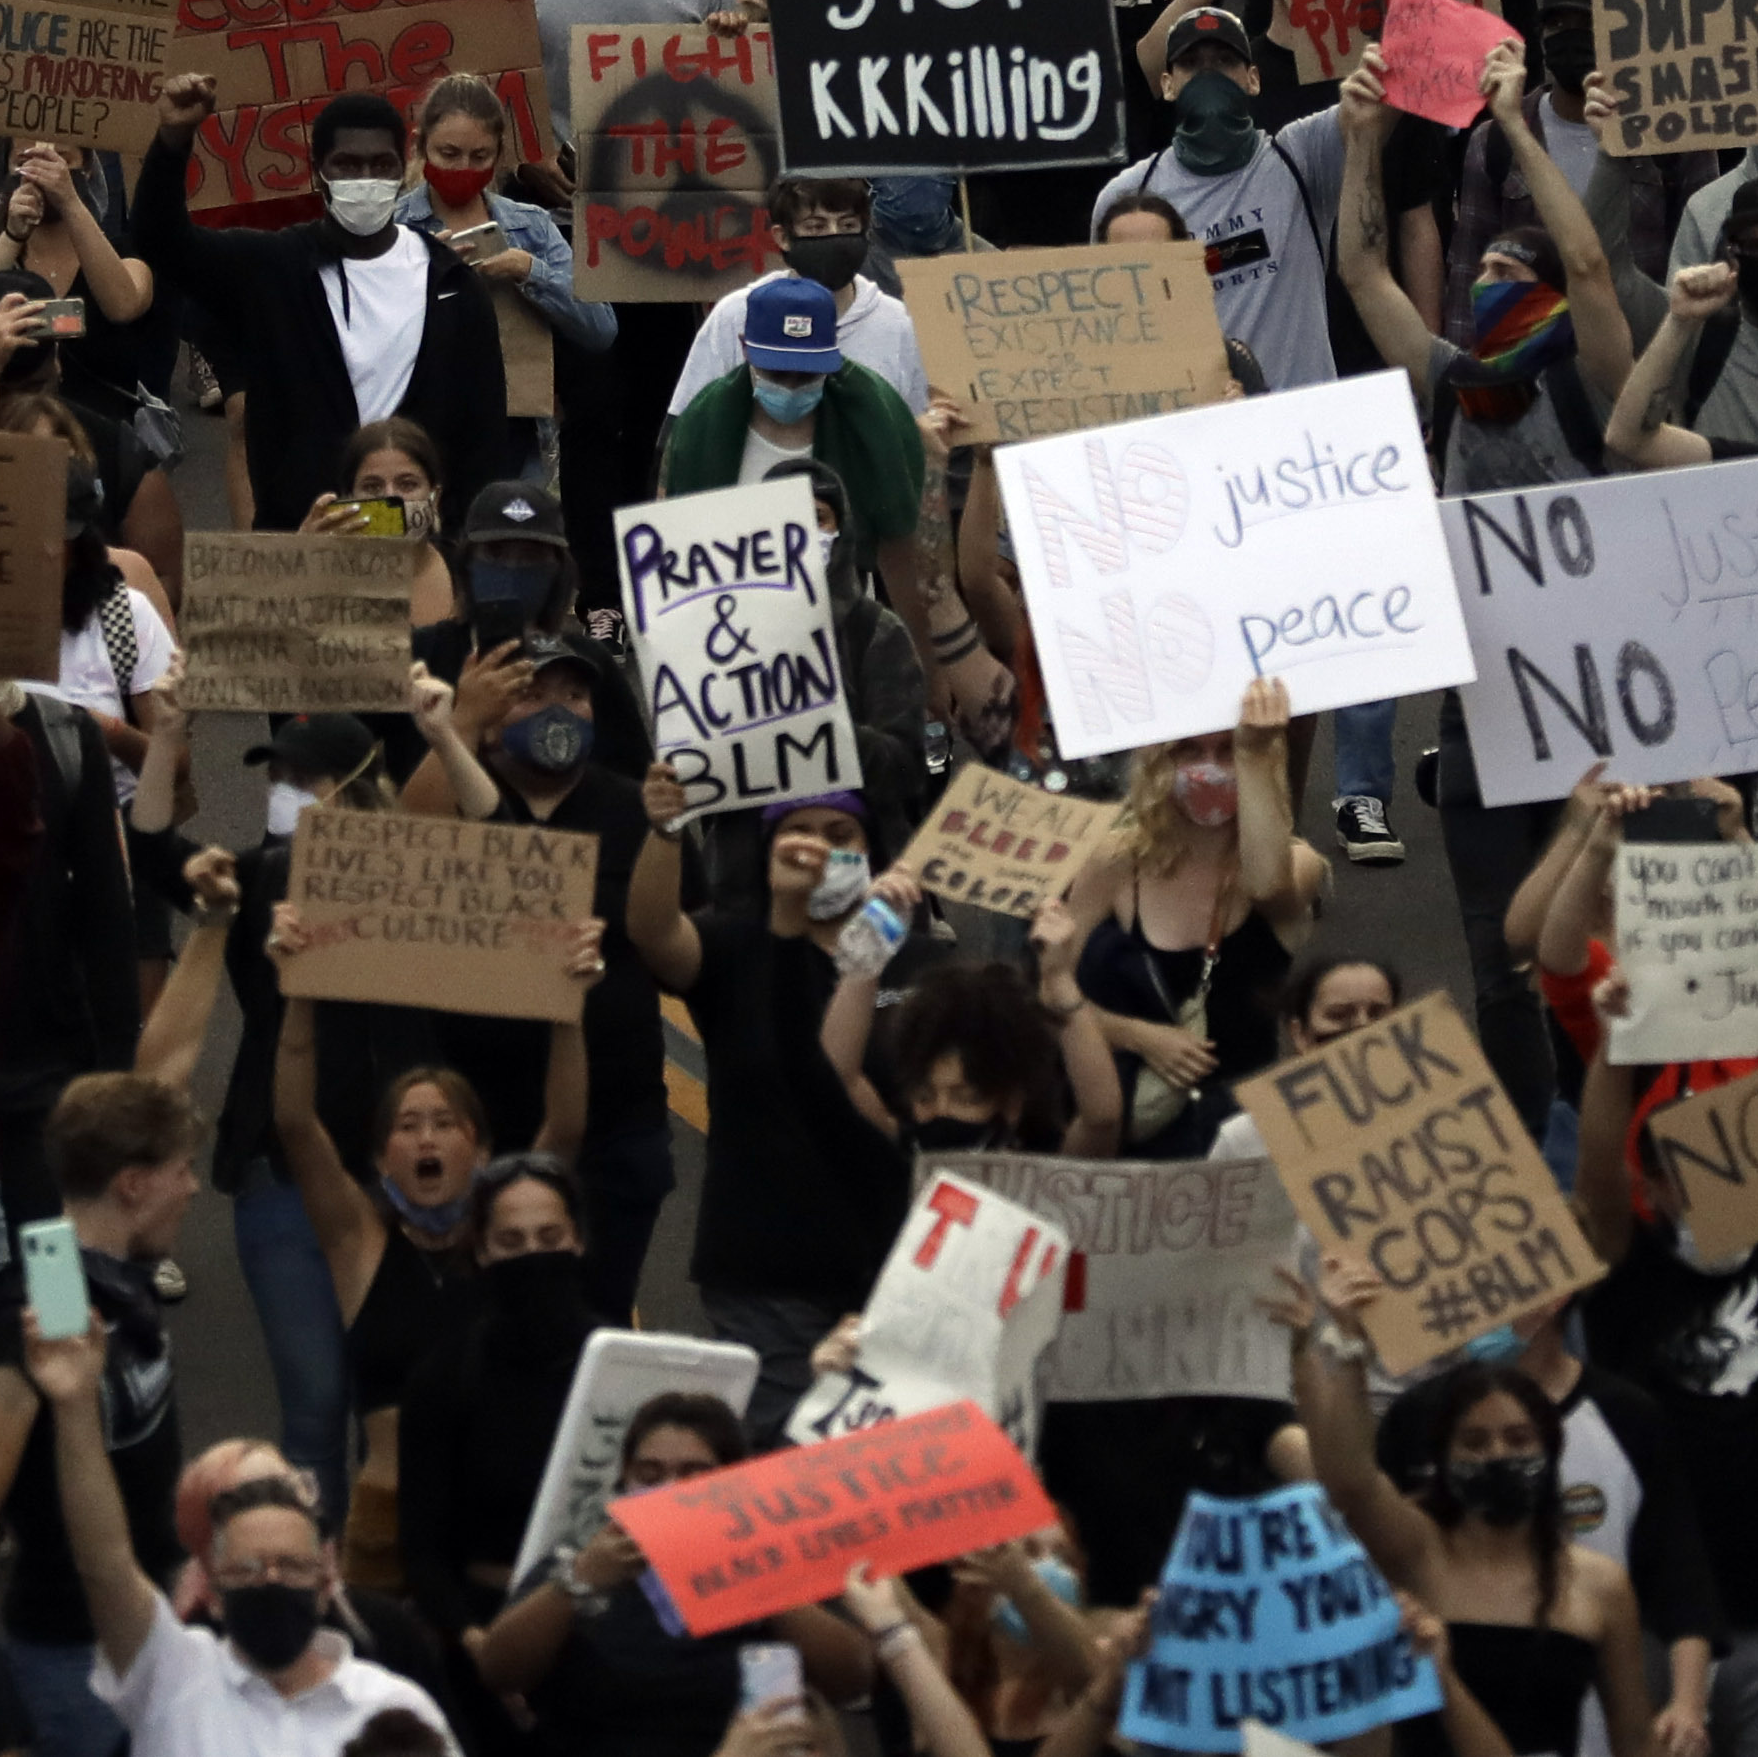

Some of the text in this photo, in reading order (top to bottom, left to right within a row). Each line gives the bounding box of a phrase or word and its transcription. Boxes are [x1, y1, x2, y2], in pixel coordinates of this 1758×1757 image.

[624, 521, 811, 636] PRAYER
[705, 595, 756, 657] &
[652, 628, 838, 744] ACTION
[663, 725, 841, 805] BLM
[1272, 1012, 1461, 1151] FUCK
[1310, 1086, 1514, 1240] RACIST
[1367, 1166, 1535, 1293] COPS
[1416, 1226, 1577, 1337] #BLM
